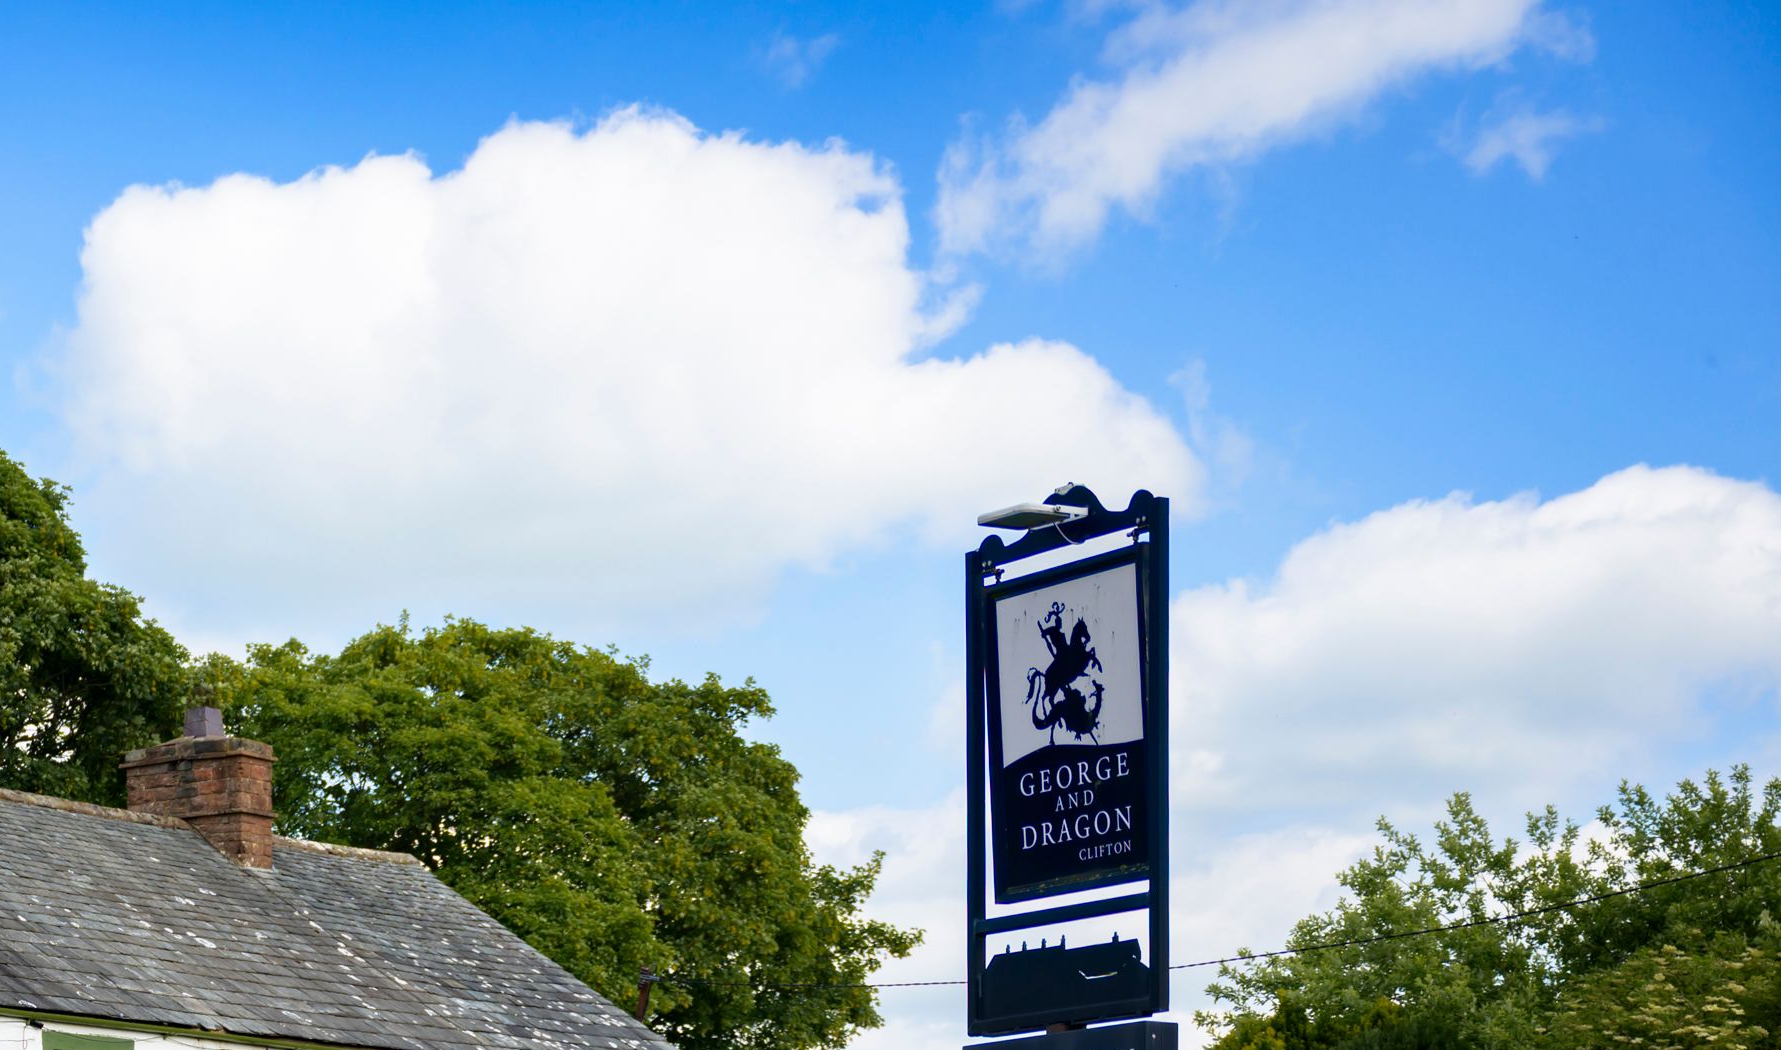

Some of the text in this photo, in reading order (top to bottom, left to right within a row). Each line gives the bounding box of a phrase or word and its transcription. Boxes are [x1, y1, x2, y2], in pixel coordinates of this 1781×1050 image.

[1020, 752, 1130, 797] GEORGE
[1055, 789, 1094, 812] AND
[1021, 805, 1132, 850] DRAGON
[1078, 840, 1132, 861] CLIFTON
